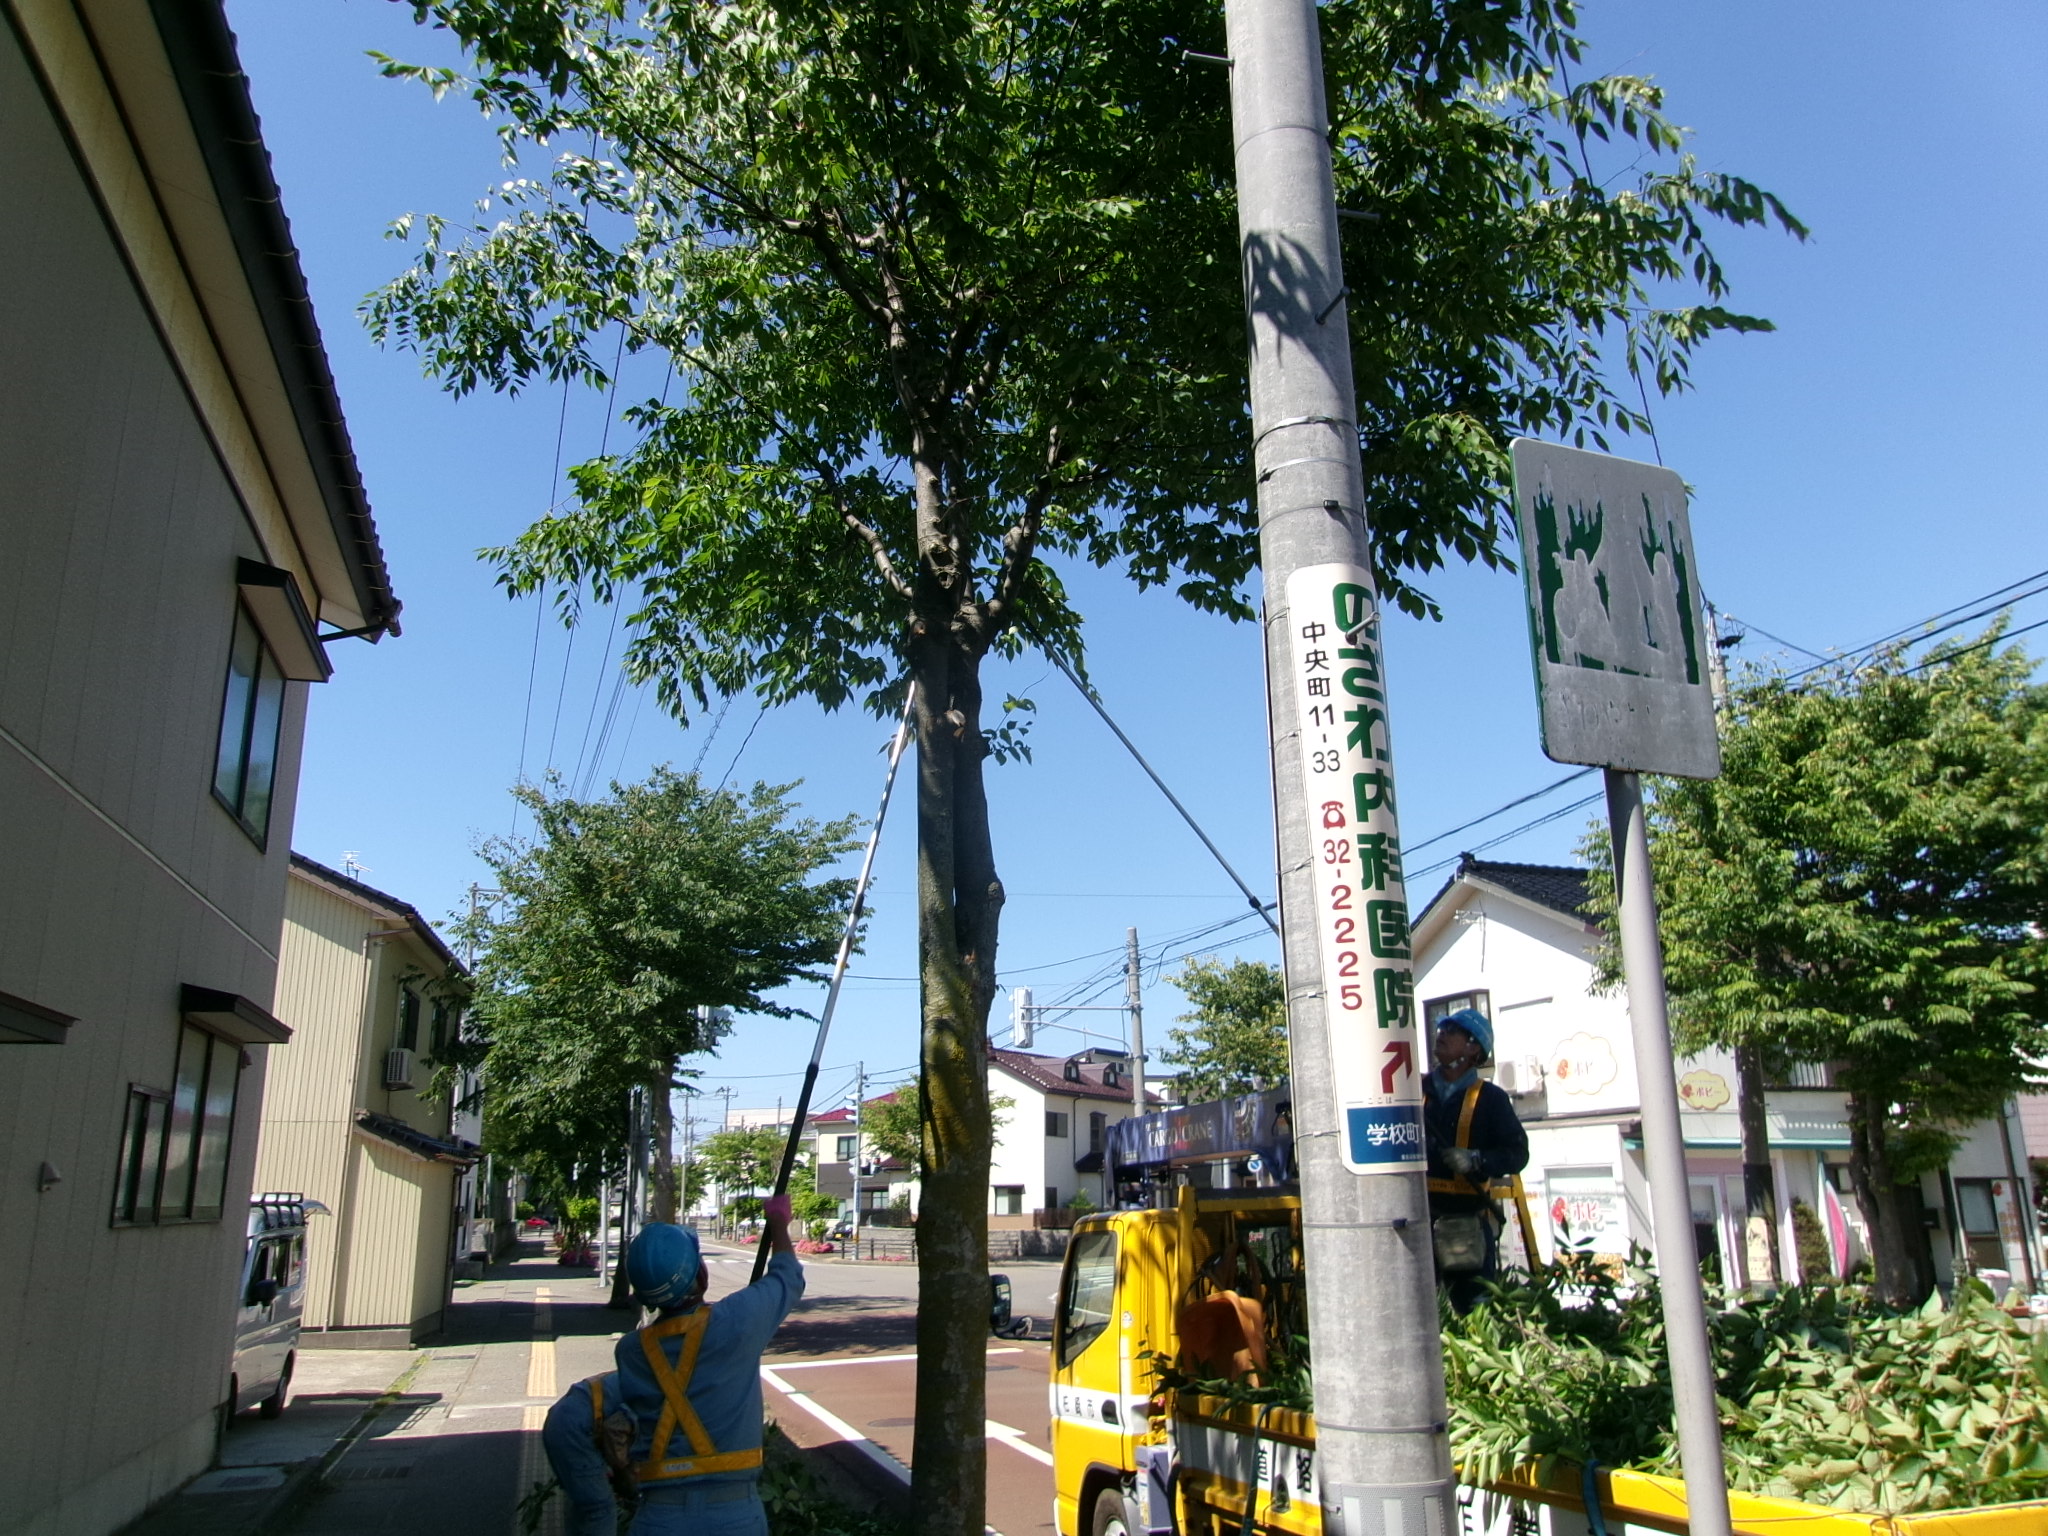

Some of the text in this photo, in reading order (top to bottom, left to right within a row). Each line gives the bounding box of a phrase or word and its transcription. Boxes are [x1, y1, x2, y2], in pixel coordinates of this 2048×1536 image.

[1302, 621, 1341, 774] 中央町11-33
[1332, 581, 1416, 1030] のざわ内科医院
[1322, 839, 1363, 1011] 32-2225
[1148, 1126, 1179, 1149] CARGO
[1181, 1119, 1213, 1143] CRANE
[1366, 1122, 1425, 1146] 学校町
